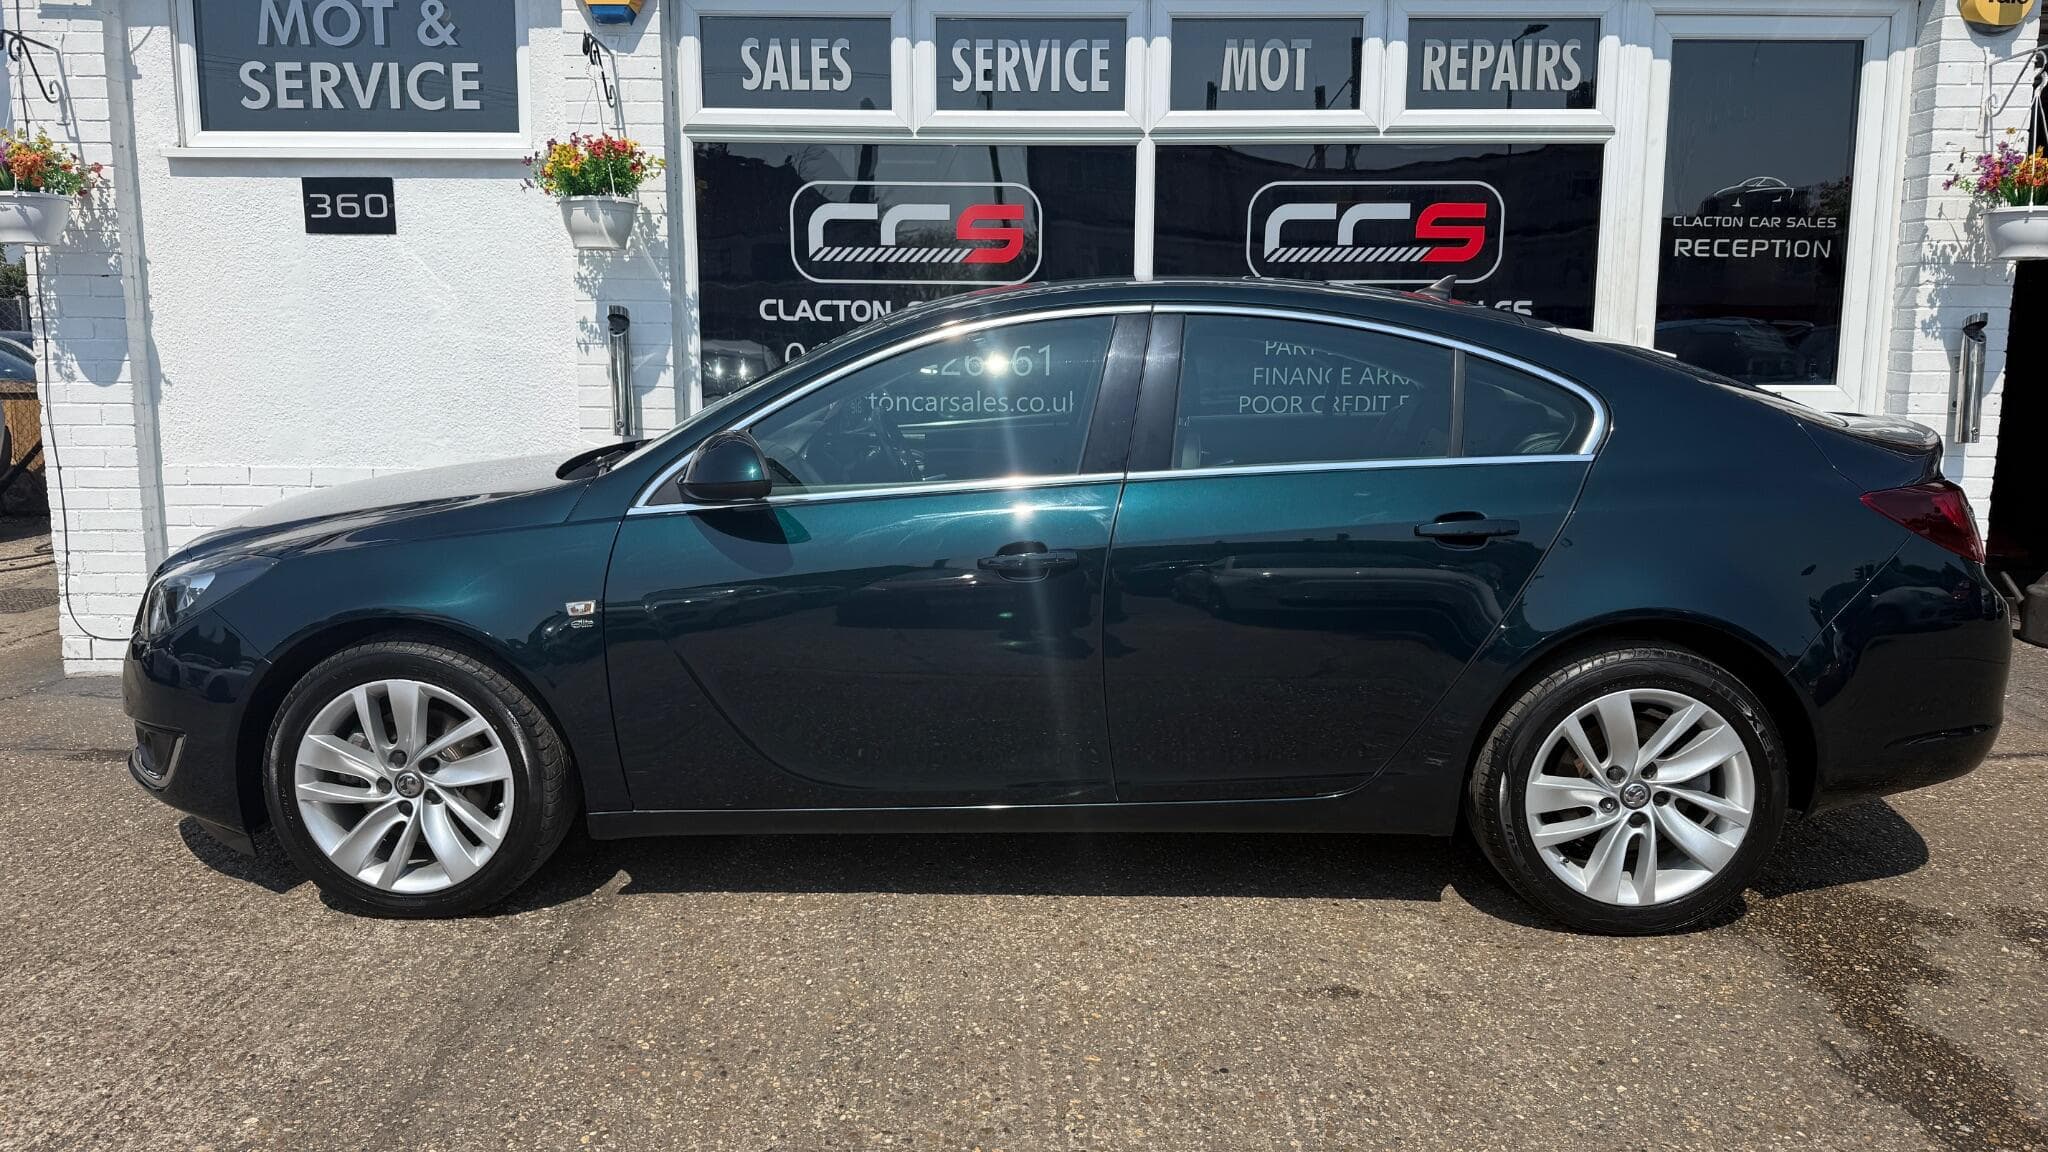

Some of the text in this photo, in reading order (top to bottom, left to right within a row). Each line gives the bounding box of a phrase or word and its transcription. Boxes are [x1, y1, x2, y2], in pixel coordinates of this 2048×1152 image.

[257, 0, 458, 46] MOT &
[740, 37, 852, 92] SALES
[951, 38, 1111, 92] SERVICE
[1220, 38, 1312, 92] MOT
[1422, 39, 1582, 91] REPAIRS
[239, 61, 482, 111] SERVICE
[309, 193, 388, 218] 360
[1673, 215, 1837, 229] CLACTON CAR SALES
[1674, 238, 1831, 258] RECEPTION
[759, 299, 891, 321] CLACTON
[865, 390, 1073, 413] toncarsales.co.u
[1239, 395, 1303, 414] POOR
